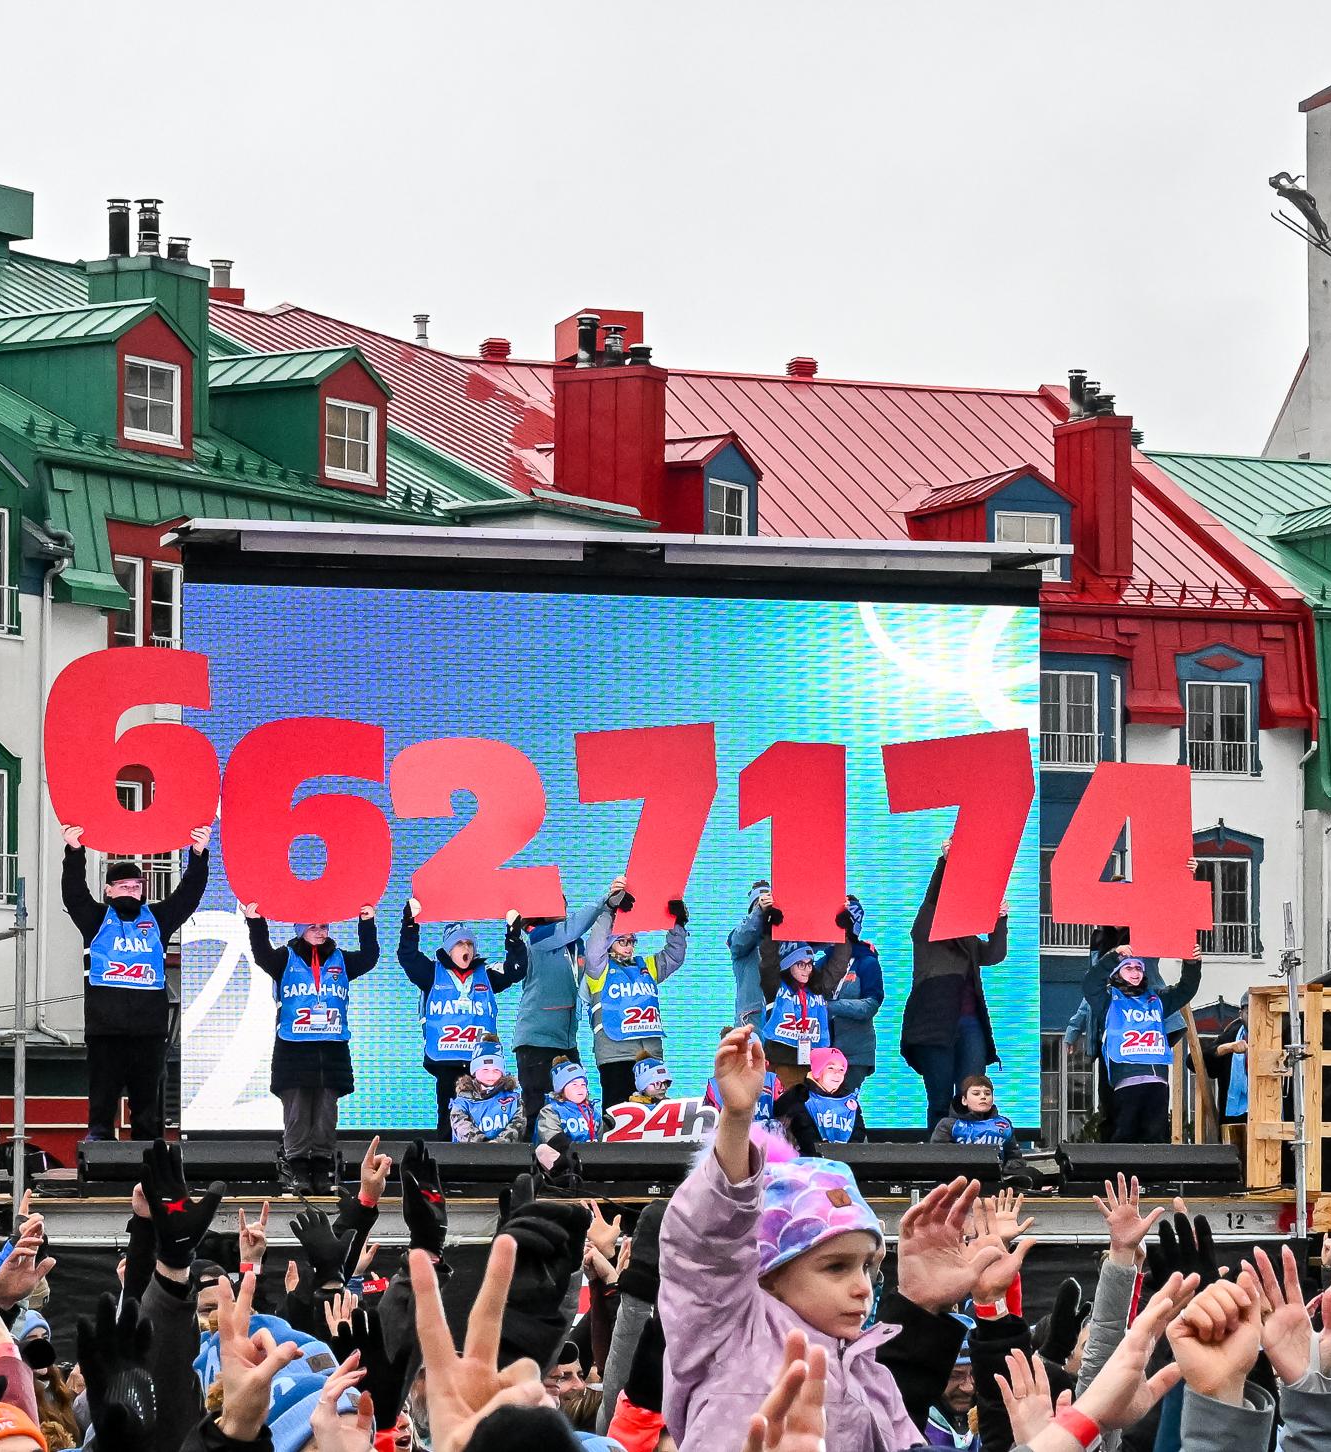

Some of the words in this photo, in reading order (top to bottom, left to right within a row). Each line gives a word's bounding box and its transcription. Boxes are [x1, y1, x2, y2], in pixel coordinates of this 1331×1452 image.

[44, 646, 221, 855] 6
[221, 716, 392, 923] 6
[390, 737, 566, 922] 2
[575, 722, 717, 933] 7
[739, 740, 847, 943] 1
[882, 728, 1036, 941] 7
[1051, 762, 1212, 959] 4
[113, 936, 153, 953] KARL
[105, 962, 155, 981] 24h
[1122, 1008, 1162, 1022] YOAN
[1123, 1031, 1164, 1047] 24h
[606, 1101, 716, 1142] 24h
